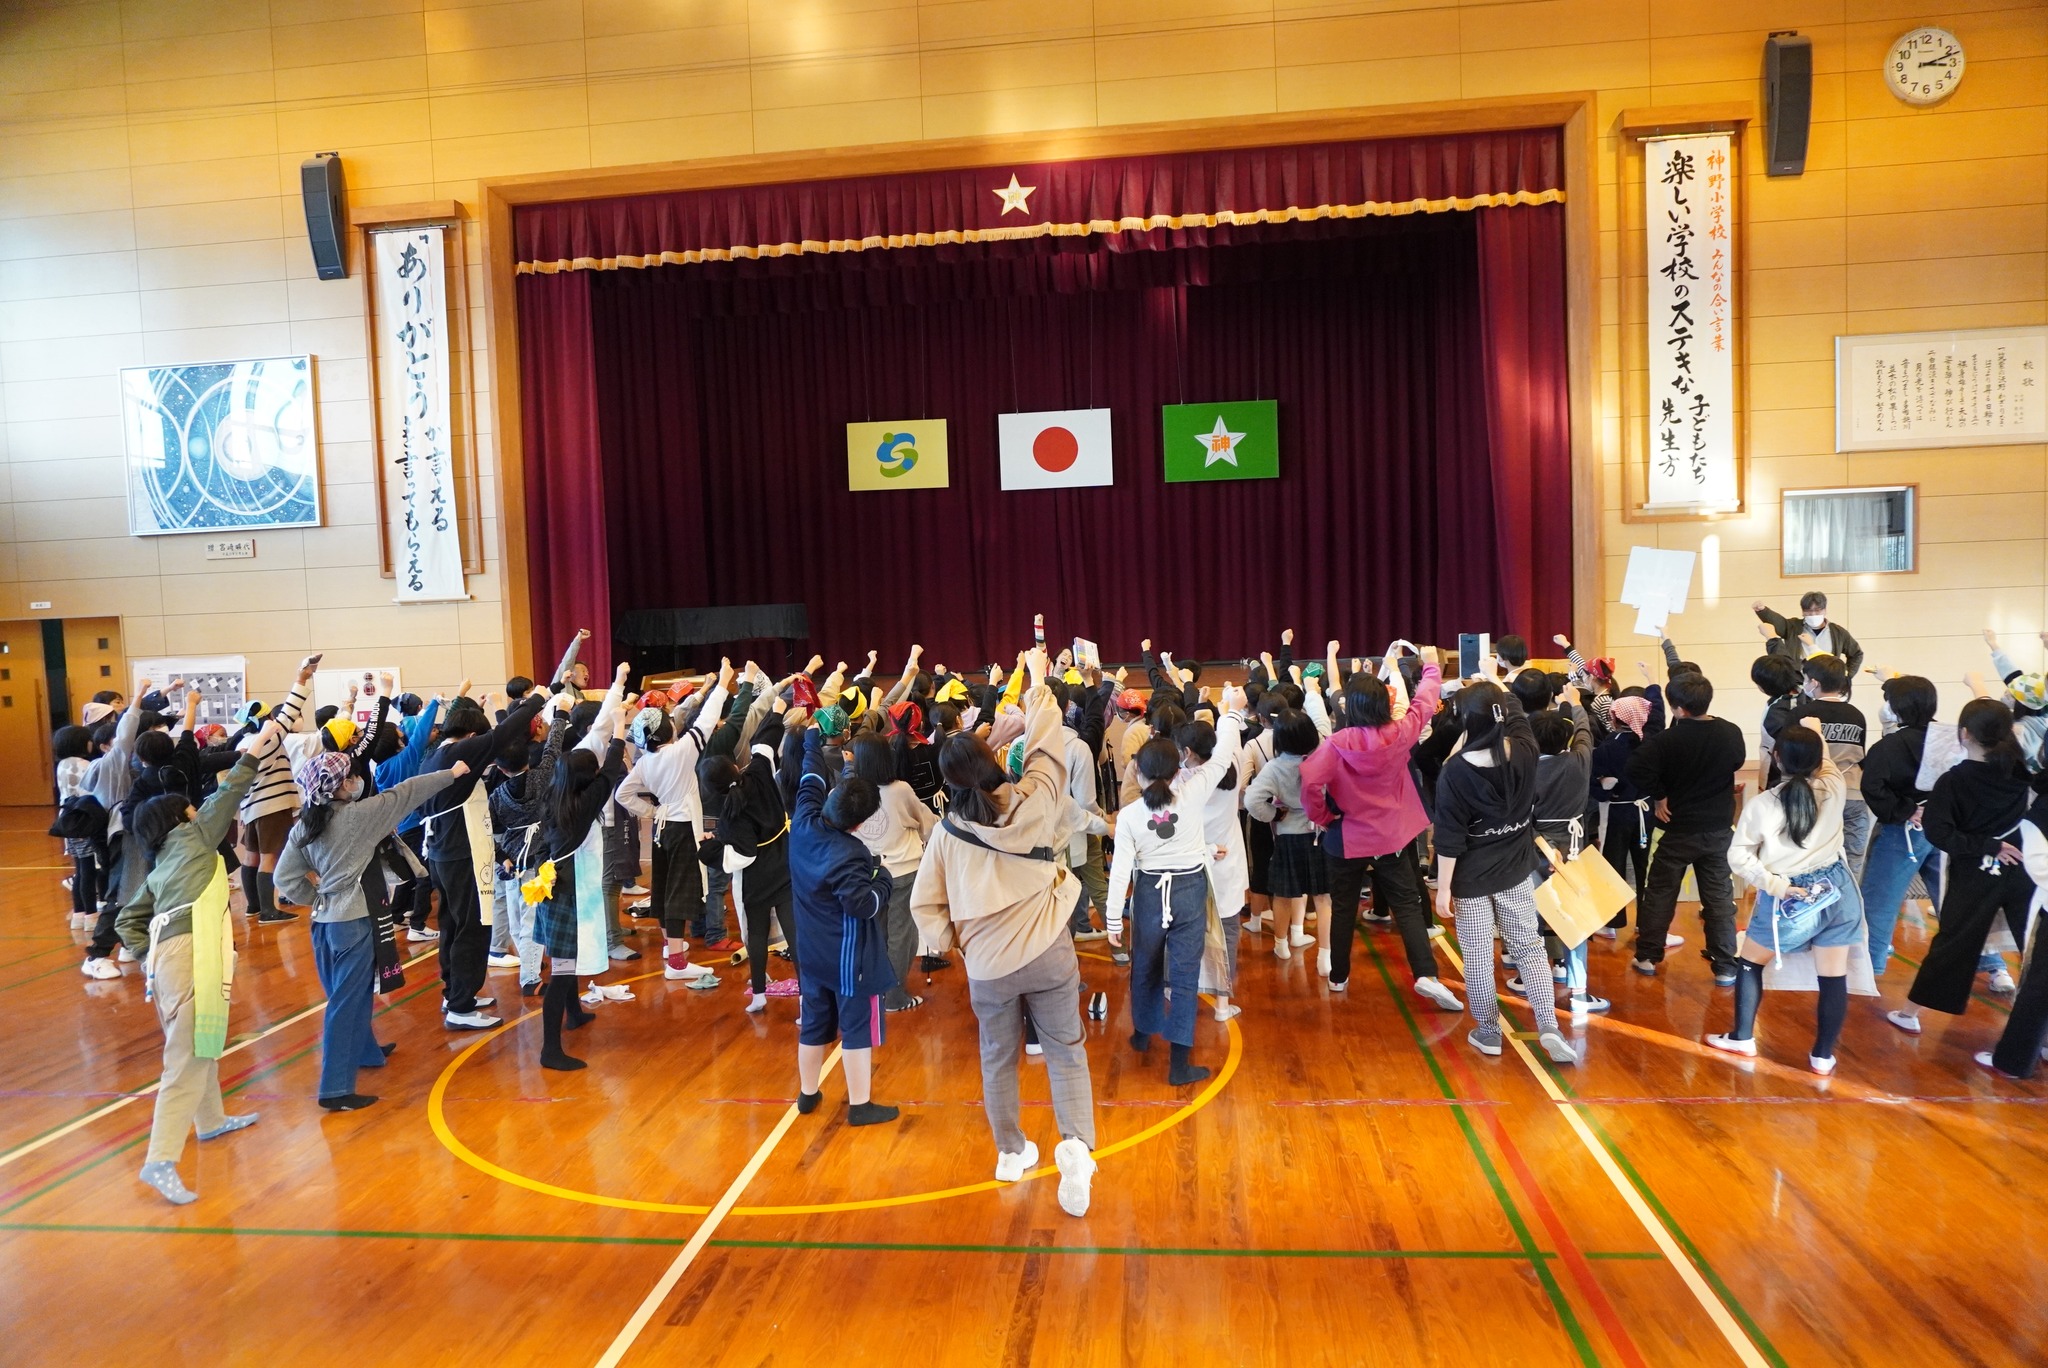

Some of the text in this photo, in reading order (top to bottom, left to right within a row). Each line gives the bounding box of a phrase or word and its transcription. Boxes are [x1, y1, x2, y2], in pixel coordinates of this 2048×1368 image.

[1907, 40, 1918, 49] 11
[1919, 34, 1932, 45] 12
[1937, 37, 1942, 48] 1
[1898, 50, 1911, 60] 10
[1944, 45, 1953, 56] 2
[1896, 62, 1904, 72] 9
[1949, 58, 1957, 67] 3
[1900, 74, 1908, 84] 8
[1944, 70, 1952, 80] 4
[1911, 82, 1919, 92] 7
[1922, 84, 1930, 94] 6
[1935, 79, 1943, 90] 5
[1706, 150, 1728, 352] 神野小学校 みんなの合い言葉
[1660, 149, 1700, 395] 楽しい学校のステキな
[2022, 359, 2035, 388] 校歌
[1658, 397, 1682, 478] 先生方
[1689, 393, 1711, 486] 子どもたち
[1211, 434, 1231, 453] 神
[370, 702, 380, 721] MOOD
[368, 723, 377, 733] THE
[359, 739, 369, 751] NOT
